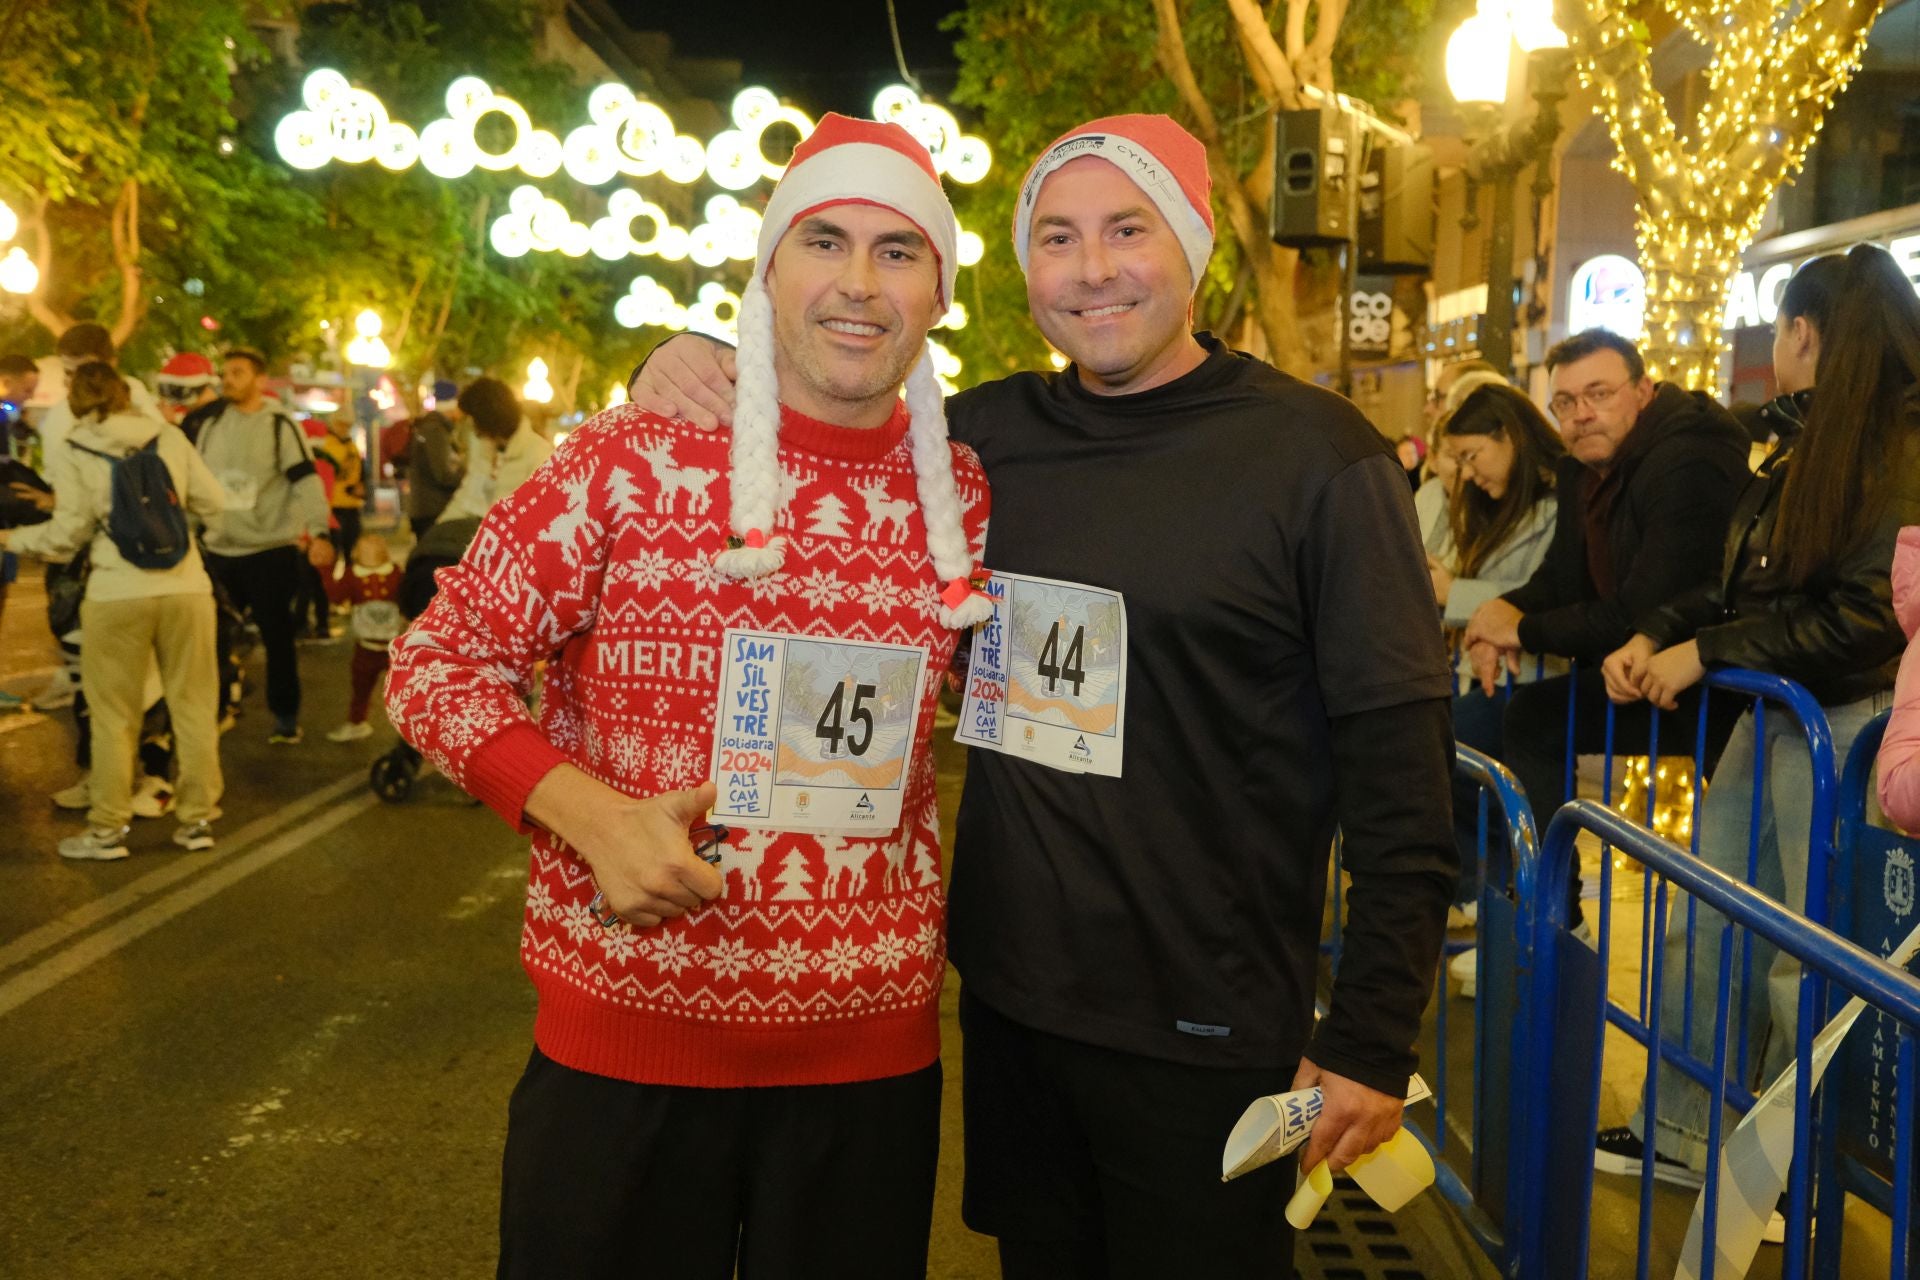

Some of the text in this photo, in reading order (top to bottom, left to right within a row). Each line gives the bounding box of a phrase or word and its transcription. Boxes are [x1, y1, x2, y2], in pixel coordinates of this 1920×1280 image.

[986, 579, 1005, 600] AN
[983, 624, 1003, 648] VES
[596, 640, 721, 682] MERR
[735, 637, 775, 663] SAN
[981, 646, 1001, 669] TRE
[1037, 621, 1086, 697] 44
[736, 688, 771, 714] VES
[971, 678, 1005, 702] 2024
[815, 681, 877, 757] 45
[976, 700, 996, 715] ALI
[733, 714, 768, 737] TRE
[976, 715, 997, 728] CAN
[974, 728, 998, 739] TE
[720, 749, 773, 773] 2024
[728, 773, 758, 787] ALI
[729, 788, 759, 802] CAN
[728, 801, 761, 814] TE
